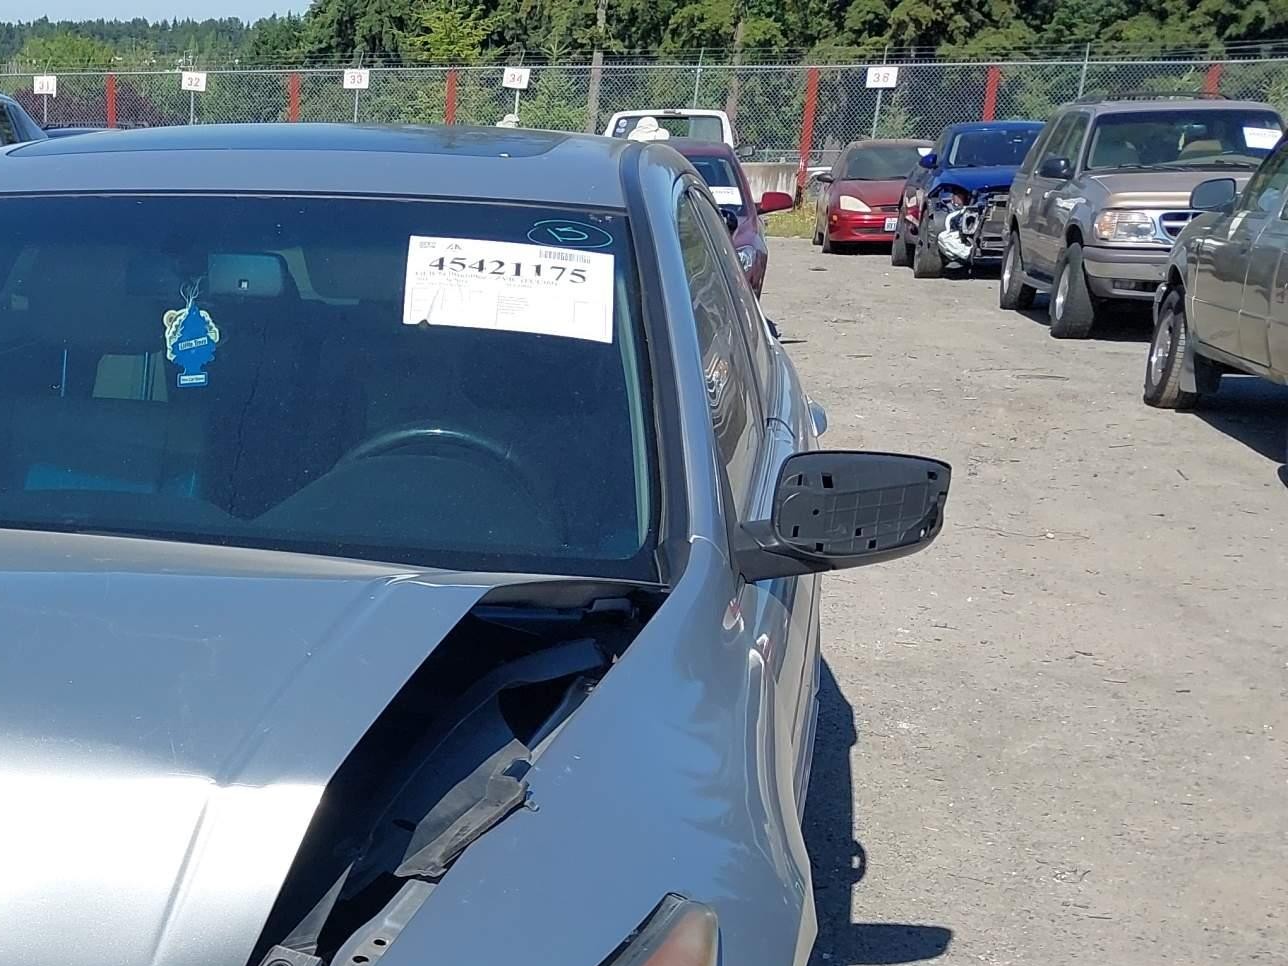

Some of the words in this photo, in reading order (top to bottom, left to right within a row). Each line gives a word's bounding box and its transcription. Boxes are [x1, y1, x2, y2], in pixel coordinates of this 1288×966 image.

[187, 77, 200, 87] 32
[350, 74, 363, 84] 33
[509, 73, 523, 84] 34
[873, 72, 890, 83] 36
[38, 81, 50, 91] 31
[428, 256, 588, 284] 45421175
